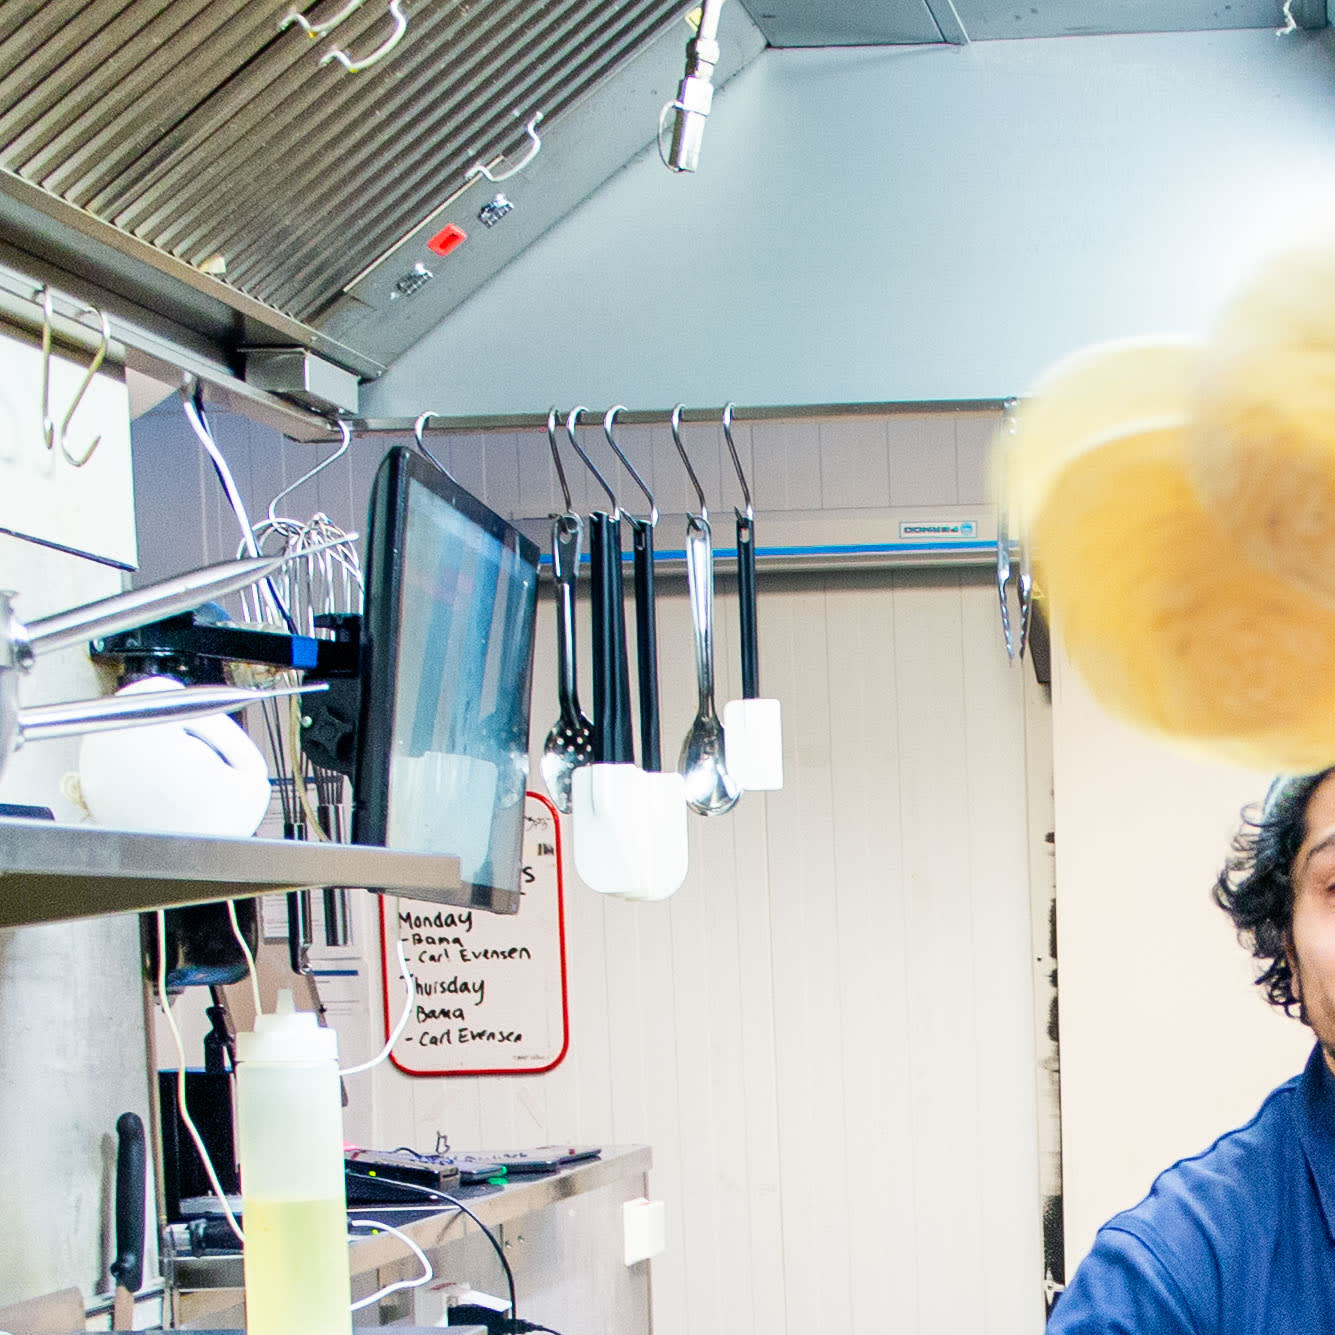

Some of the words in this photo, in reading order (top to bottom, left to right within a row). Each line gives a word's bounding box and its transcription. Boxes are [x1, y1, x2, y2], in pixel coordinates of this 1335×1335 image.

[399, 911, 473, 932] Monday
[412, 933, 464, 947] Bama
[418, 948, 449, 963] Carl
[459, 946, 531, 963] Evensen
[416, 1005, 465, 1024] Bama
[419, 1029, 452, 1046] Carl
